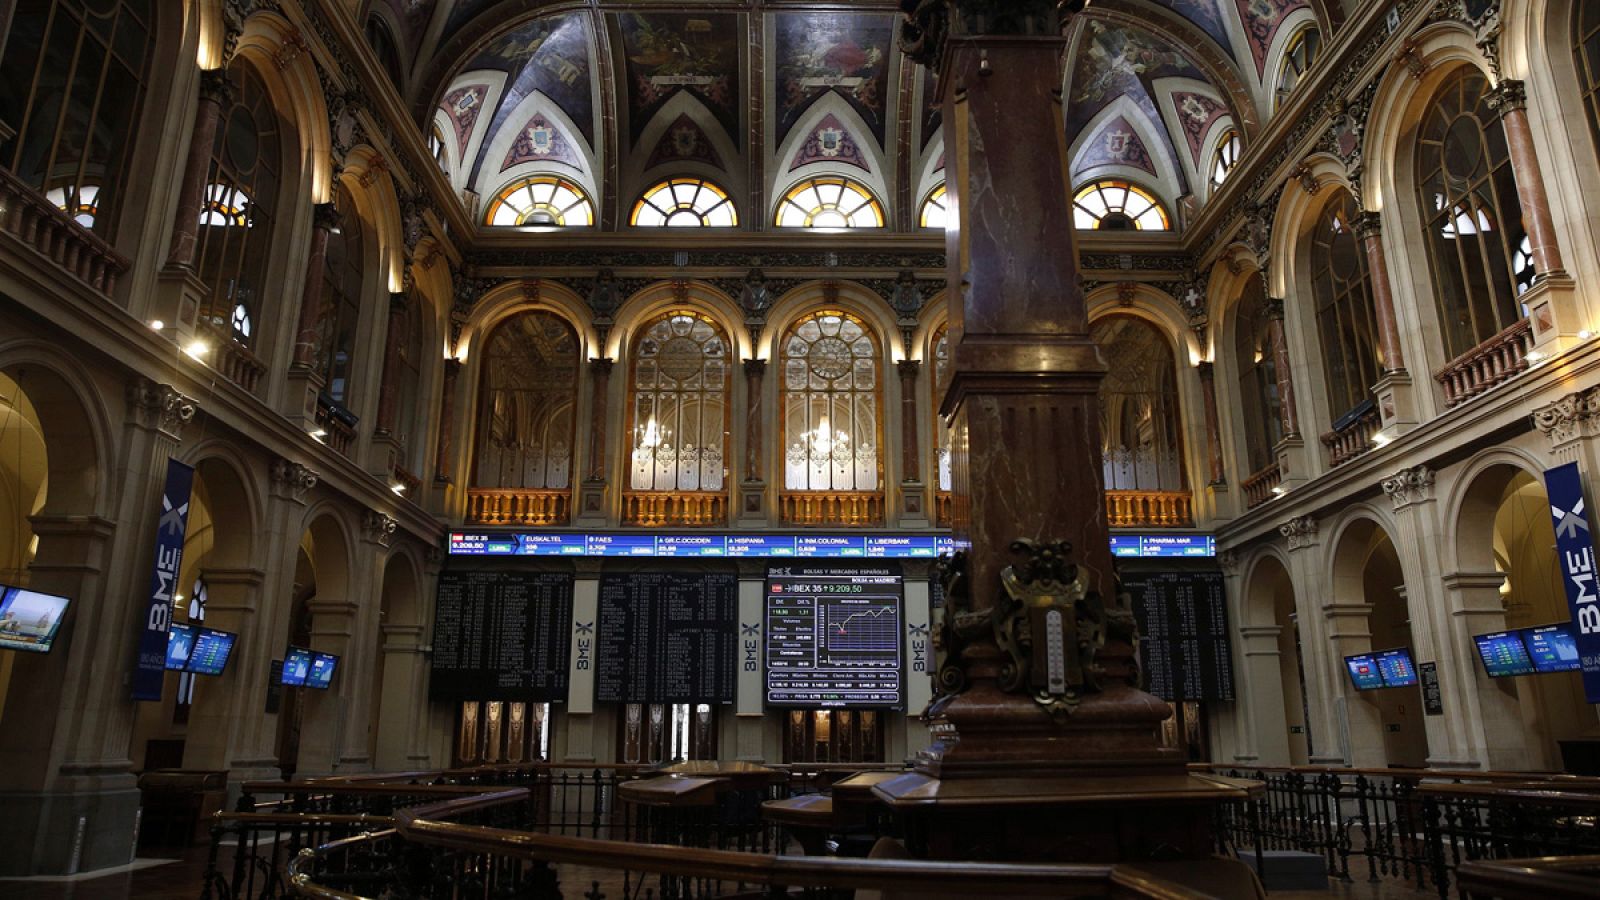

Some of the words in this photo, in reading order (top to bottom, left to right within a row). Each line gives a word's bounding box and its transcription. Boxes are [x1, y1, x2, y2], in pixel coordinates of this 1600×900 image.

[148, 544, 177, 632] BME
[860, 568, 889, 576] ESPAÑOLES
[812, 584, 823, 593] 35
[828, 584, 862, 594] 9.209,50
[1566, 547, 1600, 634] BME
[576, 638, 590, 670] BME
[744, 639, 757, 672] BME
[912, 639, 925, 672] BME
